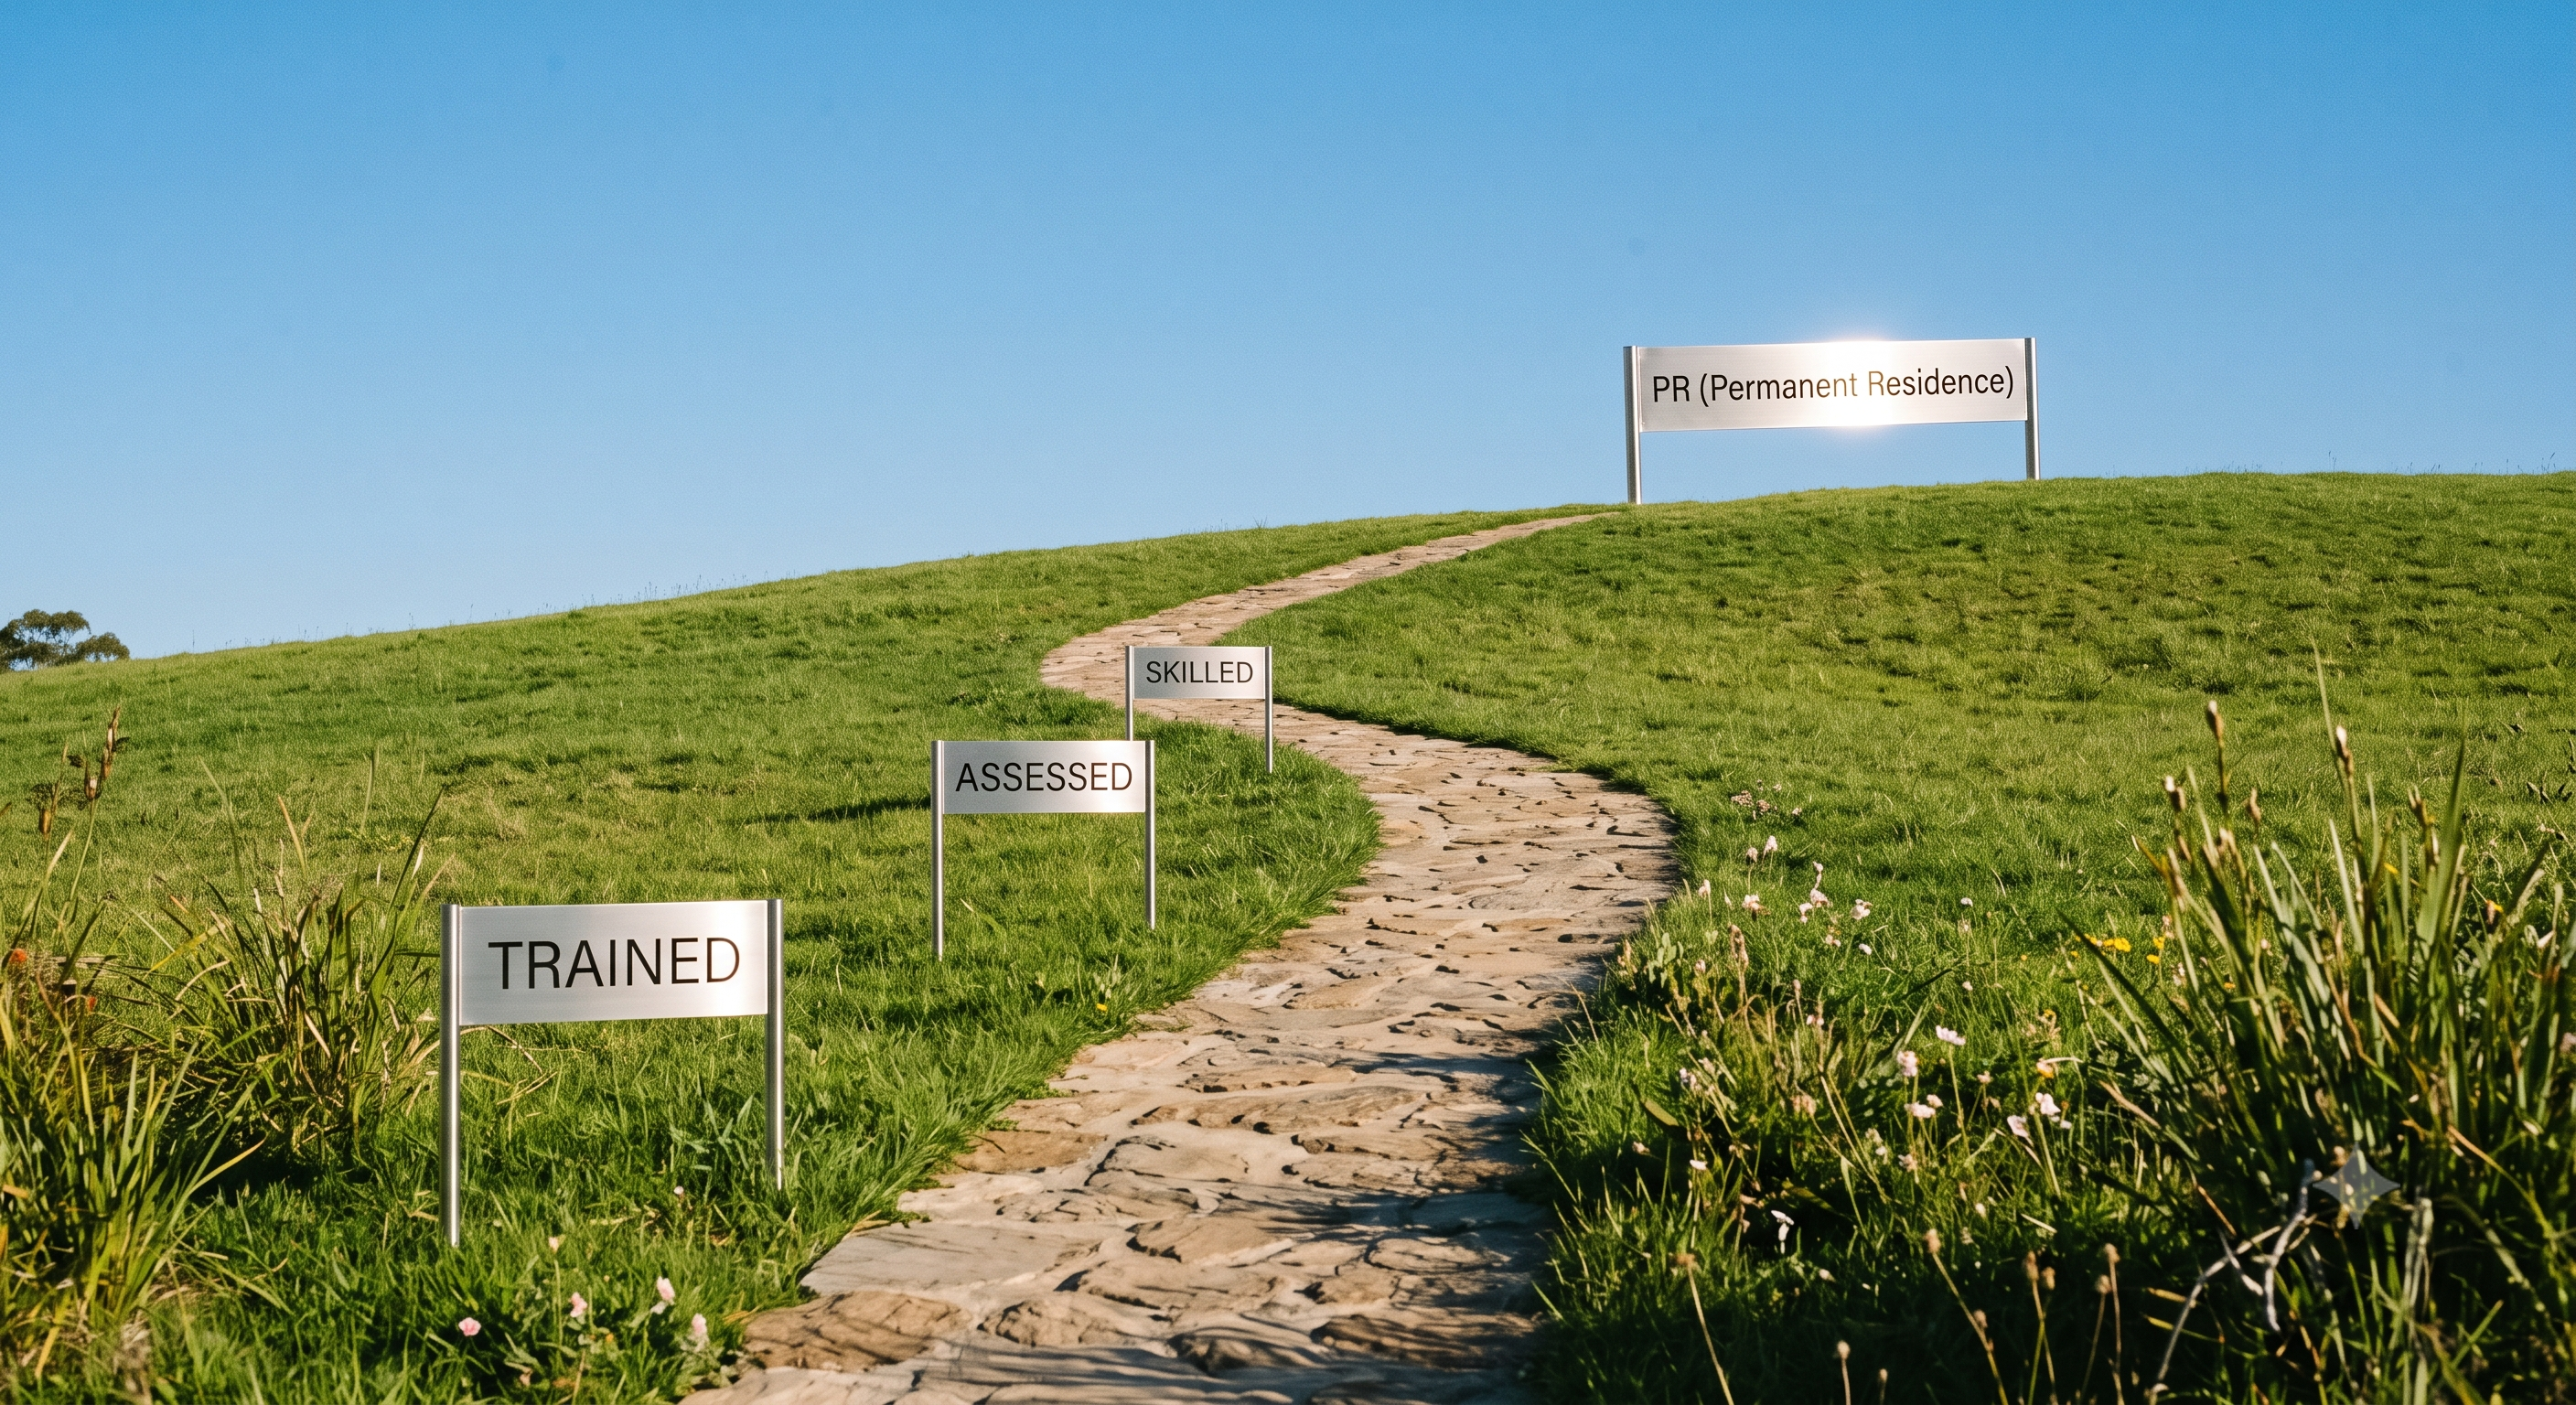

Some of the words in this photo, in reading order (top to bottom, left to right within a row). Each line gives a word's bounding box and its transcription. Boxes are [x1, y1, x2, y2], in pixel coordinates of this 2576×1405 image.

[1653, 375, 1690, 402] PR
[1700, 372, 1858, 407] (Permanent
[1868, 366, 2013, 399] Residence)
[1145, 660, 1253, 683] SKILLED
[955, 761, 1132, 791] ASSESSED
[488, 937, 740, 990] TRAINED
